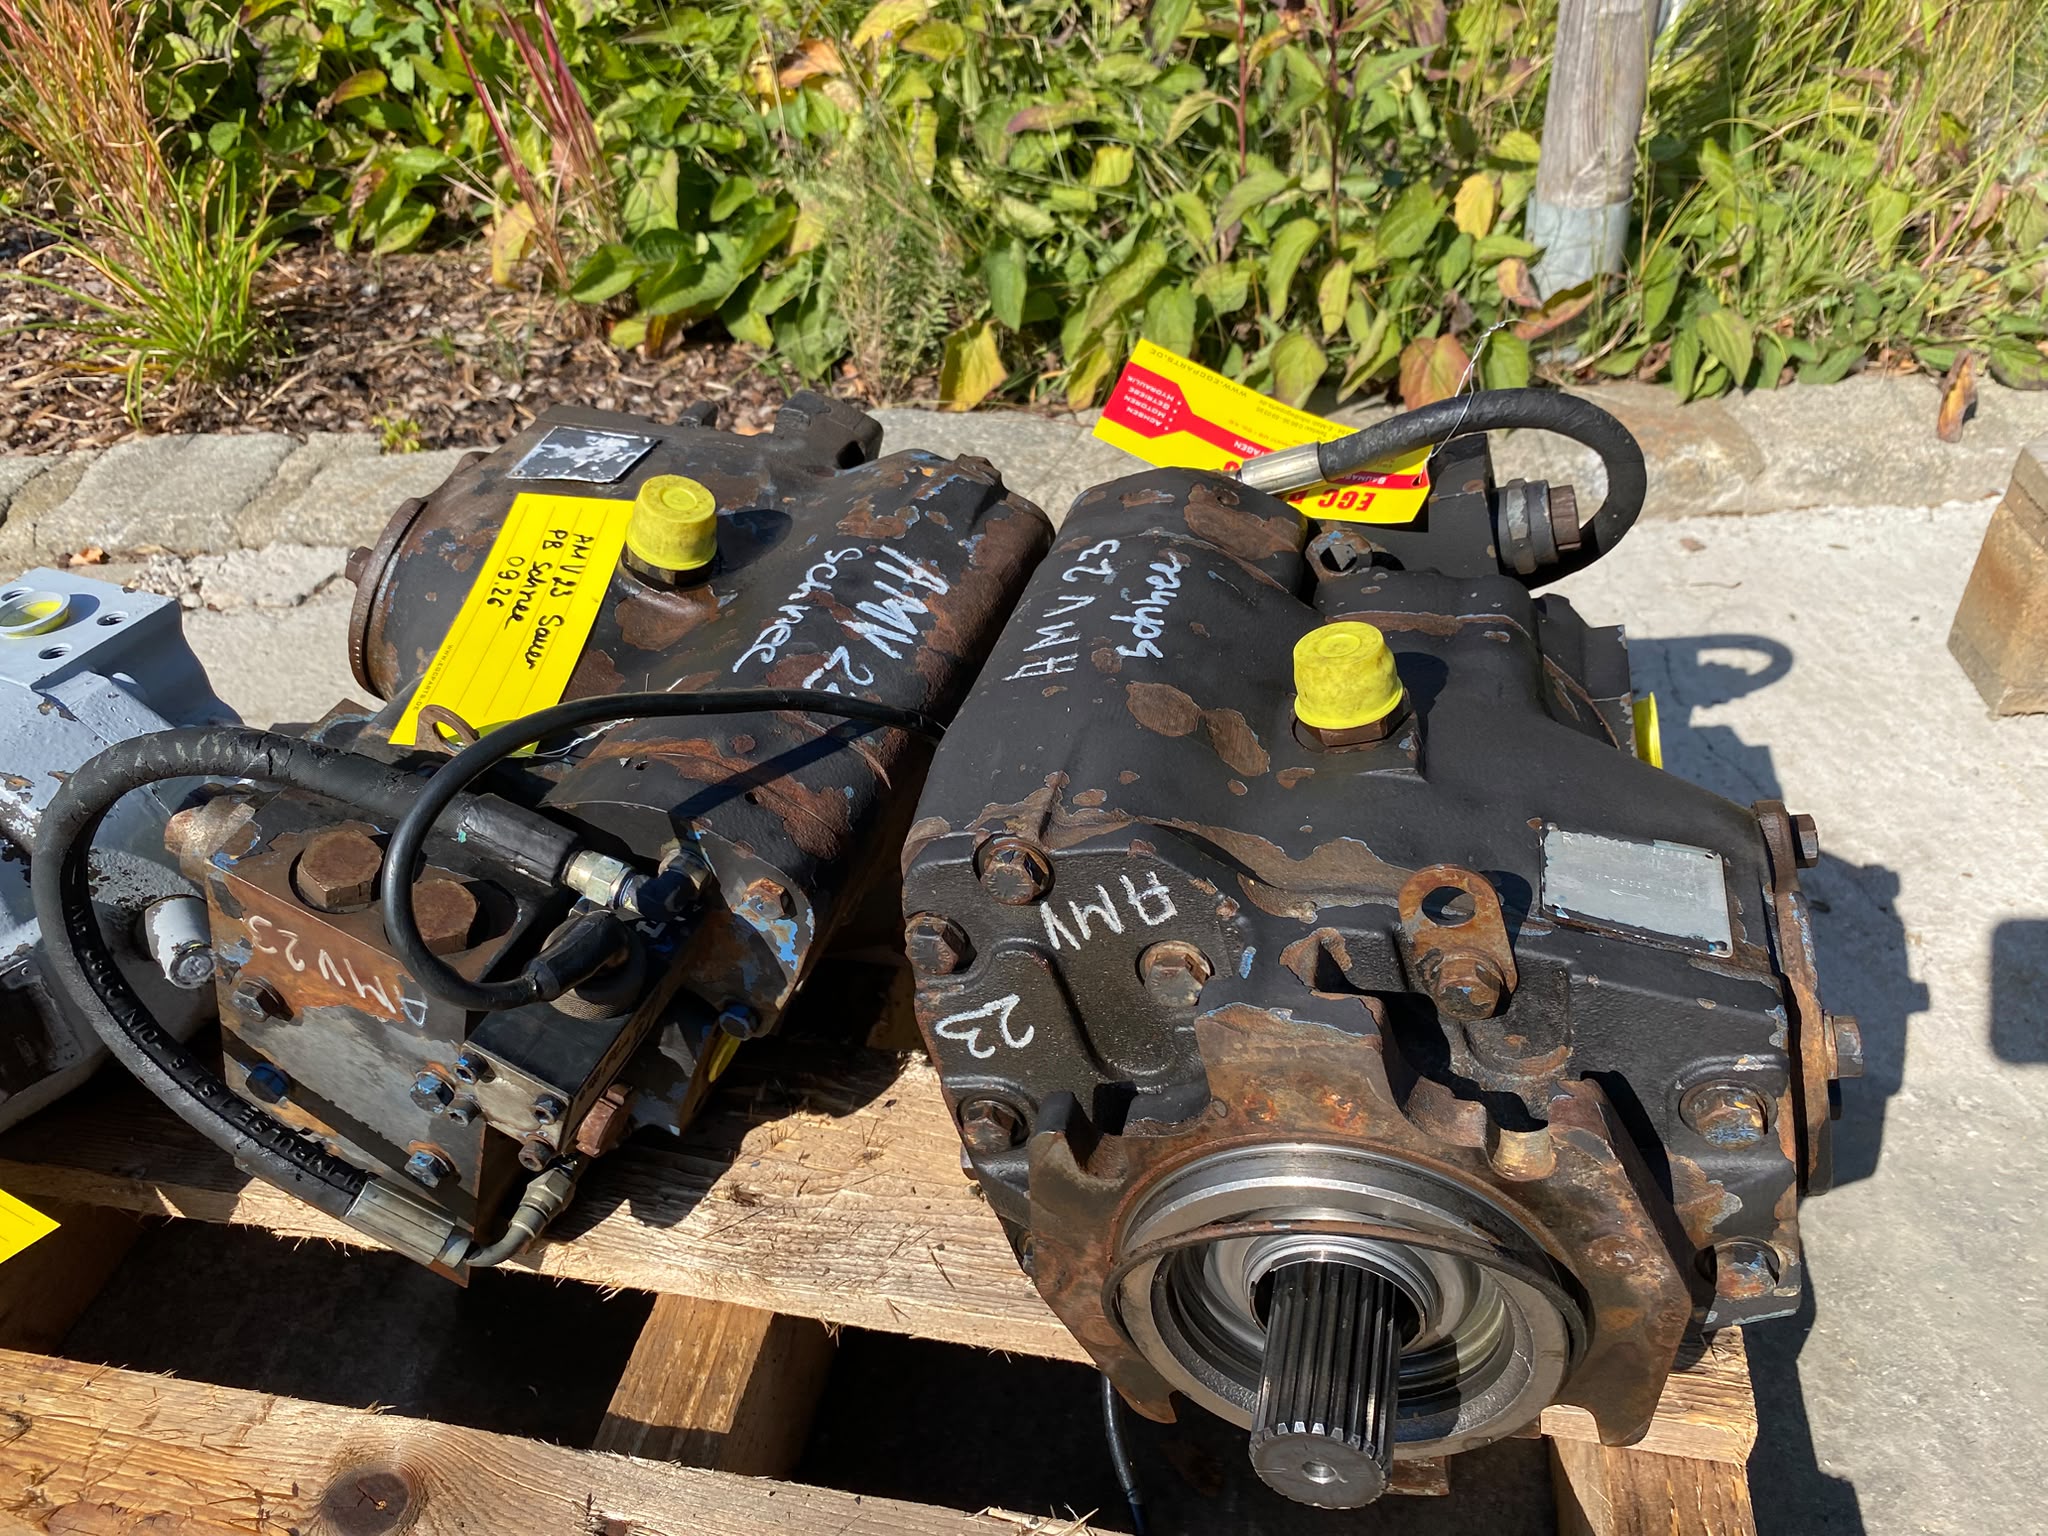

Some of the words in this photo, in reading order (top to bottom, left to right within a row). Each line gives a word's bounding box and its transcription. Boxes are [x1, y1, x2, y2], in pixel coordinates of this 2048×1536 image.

[1123, 395, 1166, 419] MOTOREN
[1126, 375, 1175, 402] HYDRAULIK
[1126, 406, 1163, 428] ACHSEN
[1317, 489, 1377, 512] EGC
[552, 577, 576, 598] 23
[842, 544, 951, 660] AMV
[1001, 594, 1096, 681] AMV
[1061, 538, 1121, 583] 23
[1040, 871, 1178, 951] AMV
[249, 914, 306, 972] 23
[318, 948, 429, 1029] AMV
[935, 993, 1035, 1059] 23
